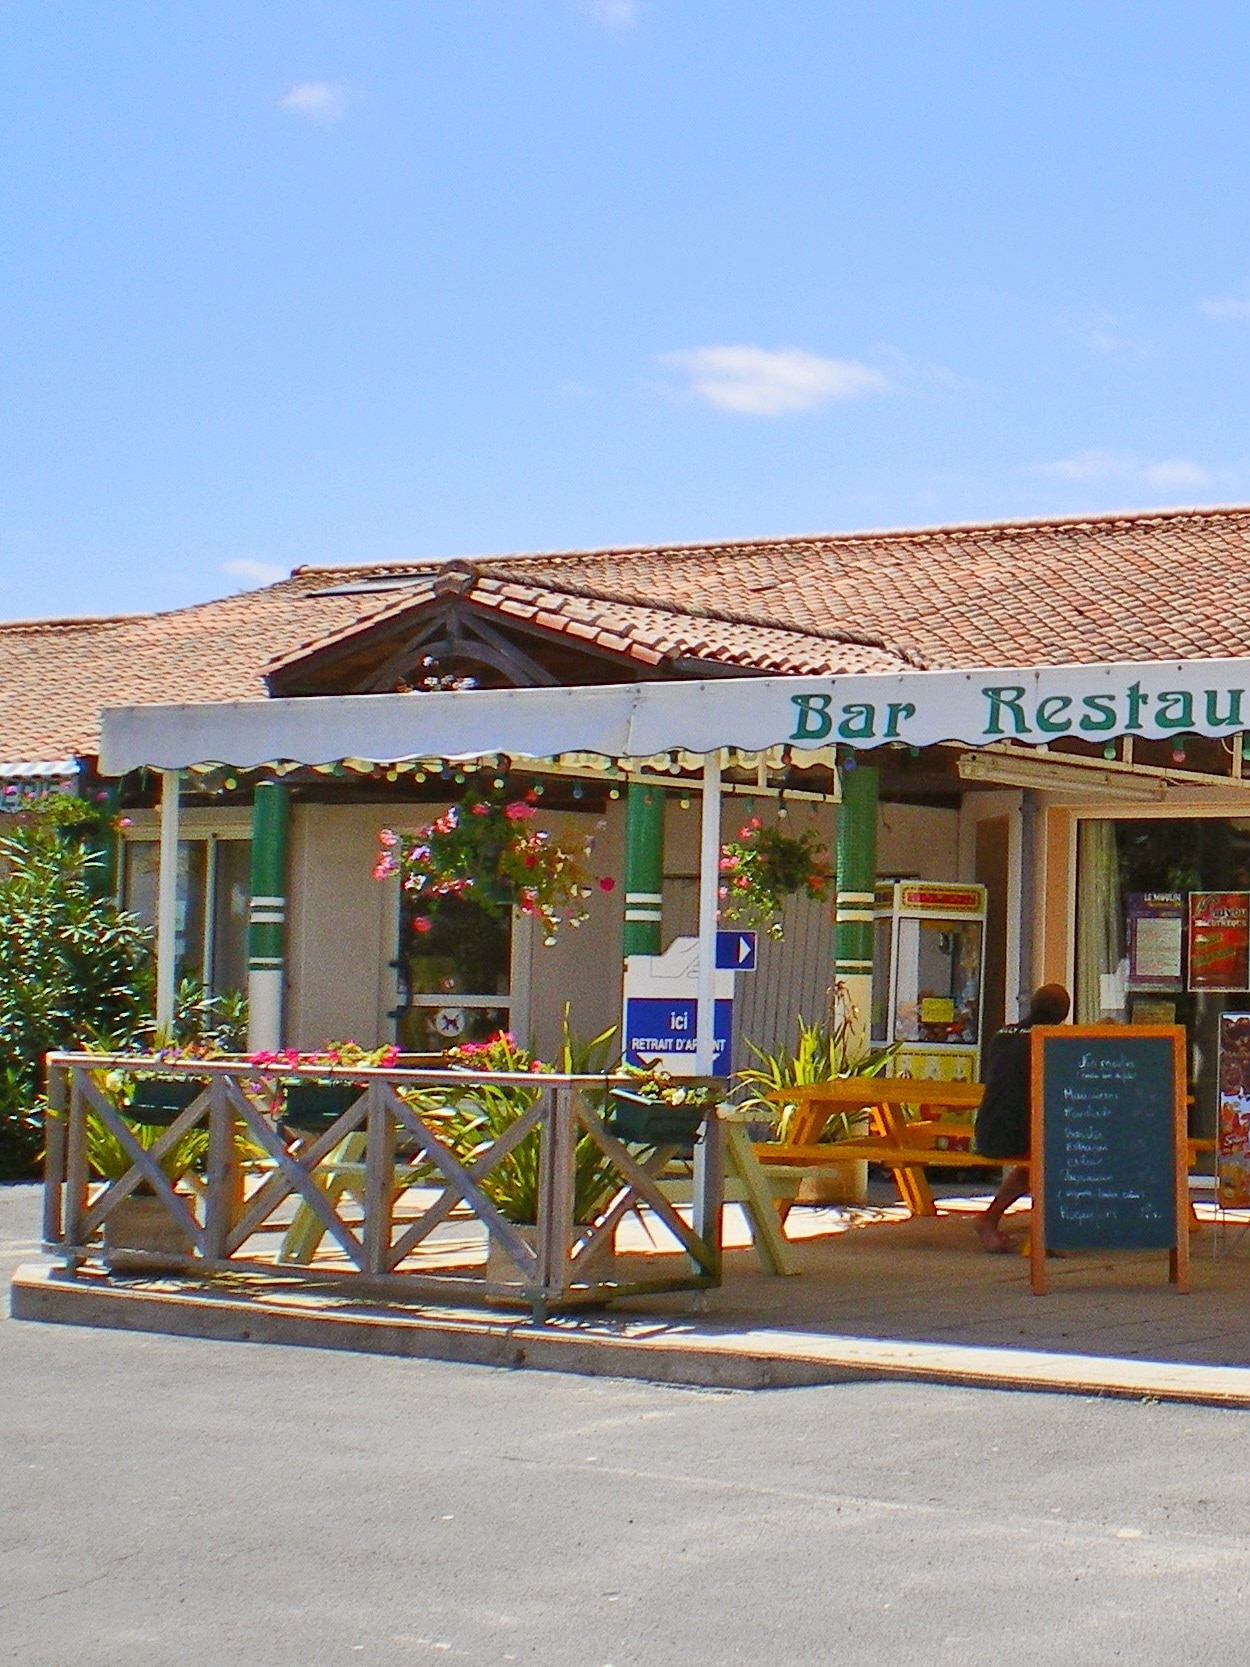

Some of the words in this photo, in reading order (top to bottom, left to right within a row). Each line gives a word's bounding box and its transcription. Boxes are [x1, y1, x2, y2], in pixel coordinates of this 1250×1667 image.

[790, 692, 916, 741] Bar
[670, 1011, 688, 1030] ici
[631, 1038, 674, 1051] RETRAIT
[675, 1038, 727, 1052] D'ARNT
